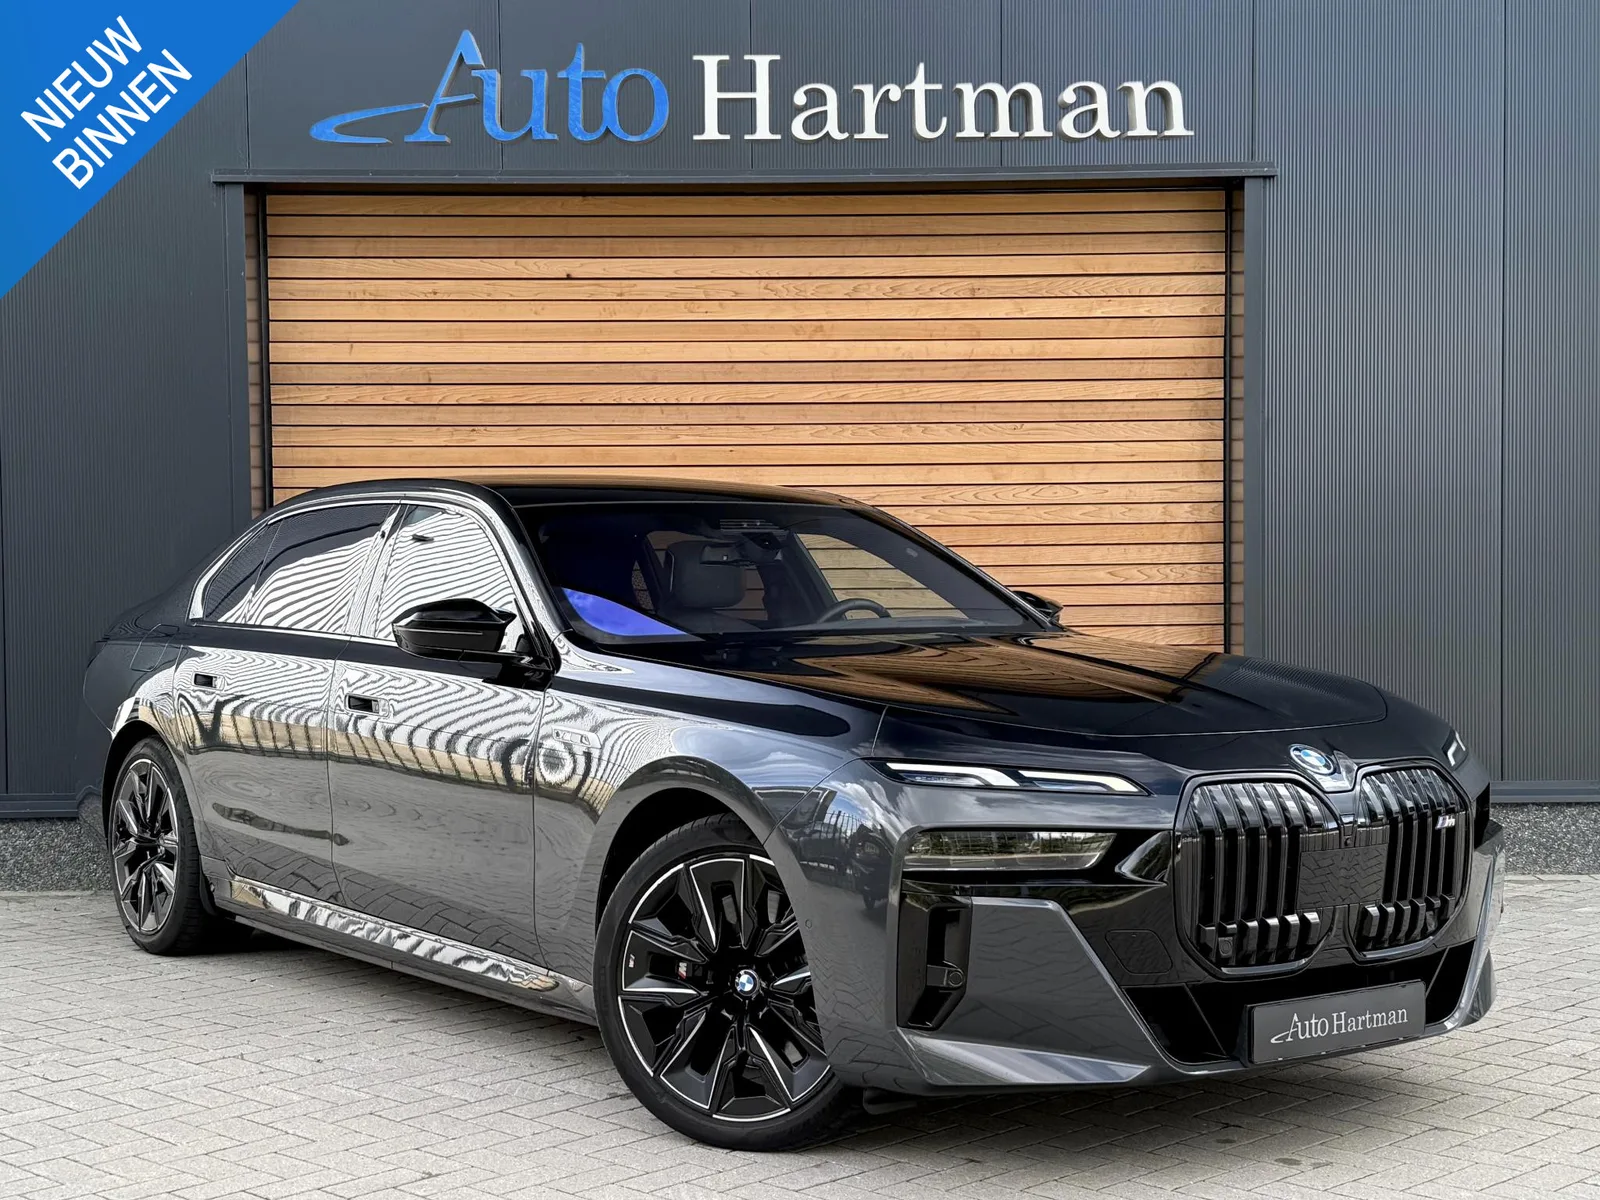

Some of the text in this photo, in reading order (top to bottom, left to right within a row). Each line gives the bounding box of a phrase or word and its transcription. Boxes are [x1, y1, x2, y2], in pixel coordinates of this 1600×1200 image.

[309, 29, 1195, 143] Auto Hartman
[1270, 1008, 1408, 1043] Auto Hartman
